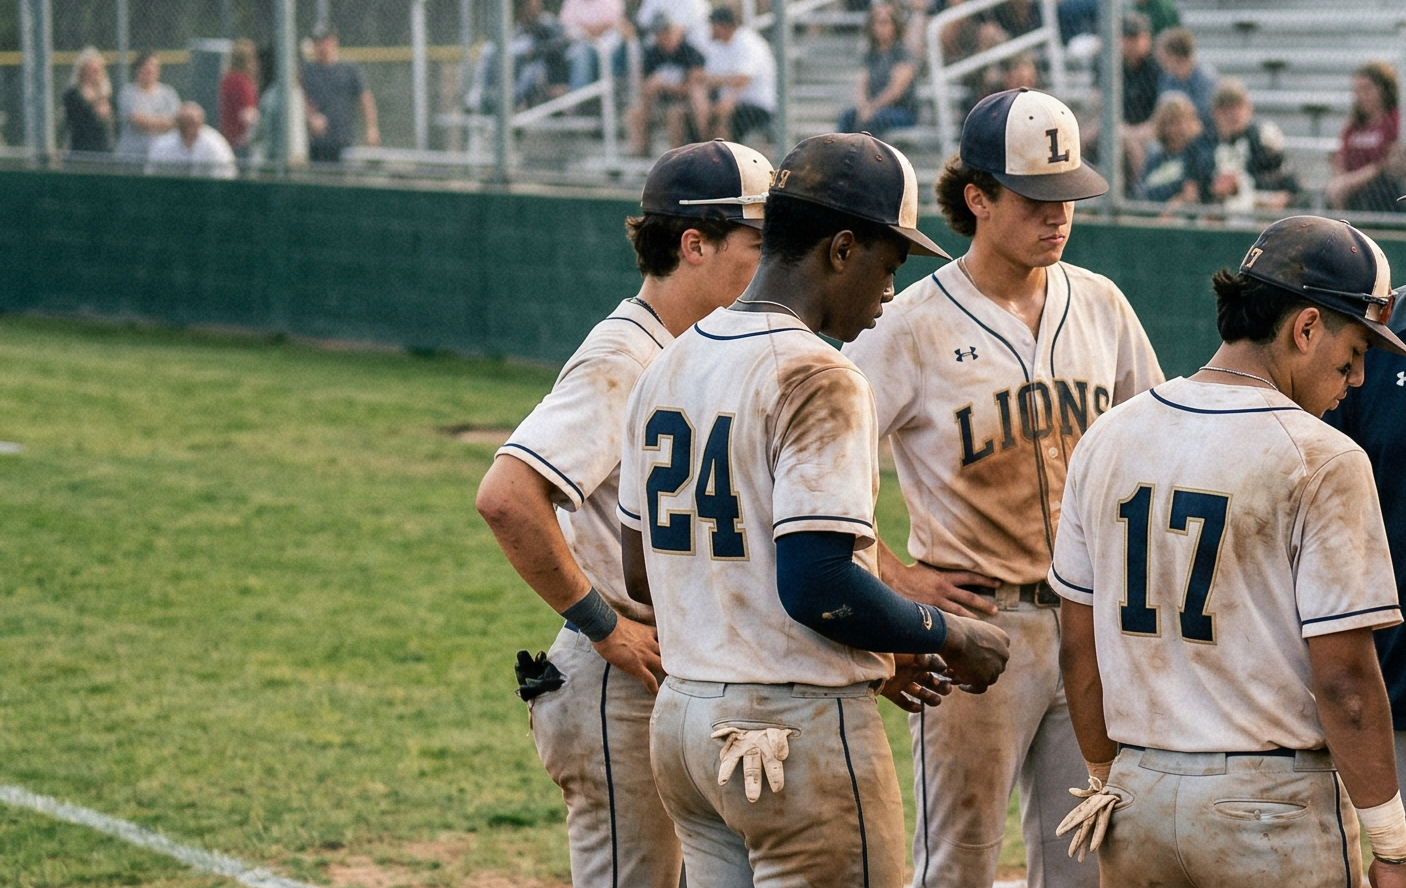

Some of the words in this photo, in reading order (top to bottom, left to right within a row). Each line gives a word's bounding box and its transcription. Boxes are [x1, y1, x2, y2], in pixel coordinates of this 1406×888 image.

[1045, 128, 1070, 164] L
[642, 405, 750, 562] 24
[1116, 482, 1234, 646] 17
